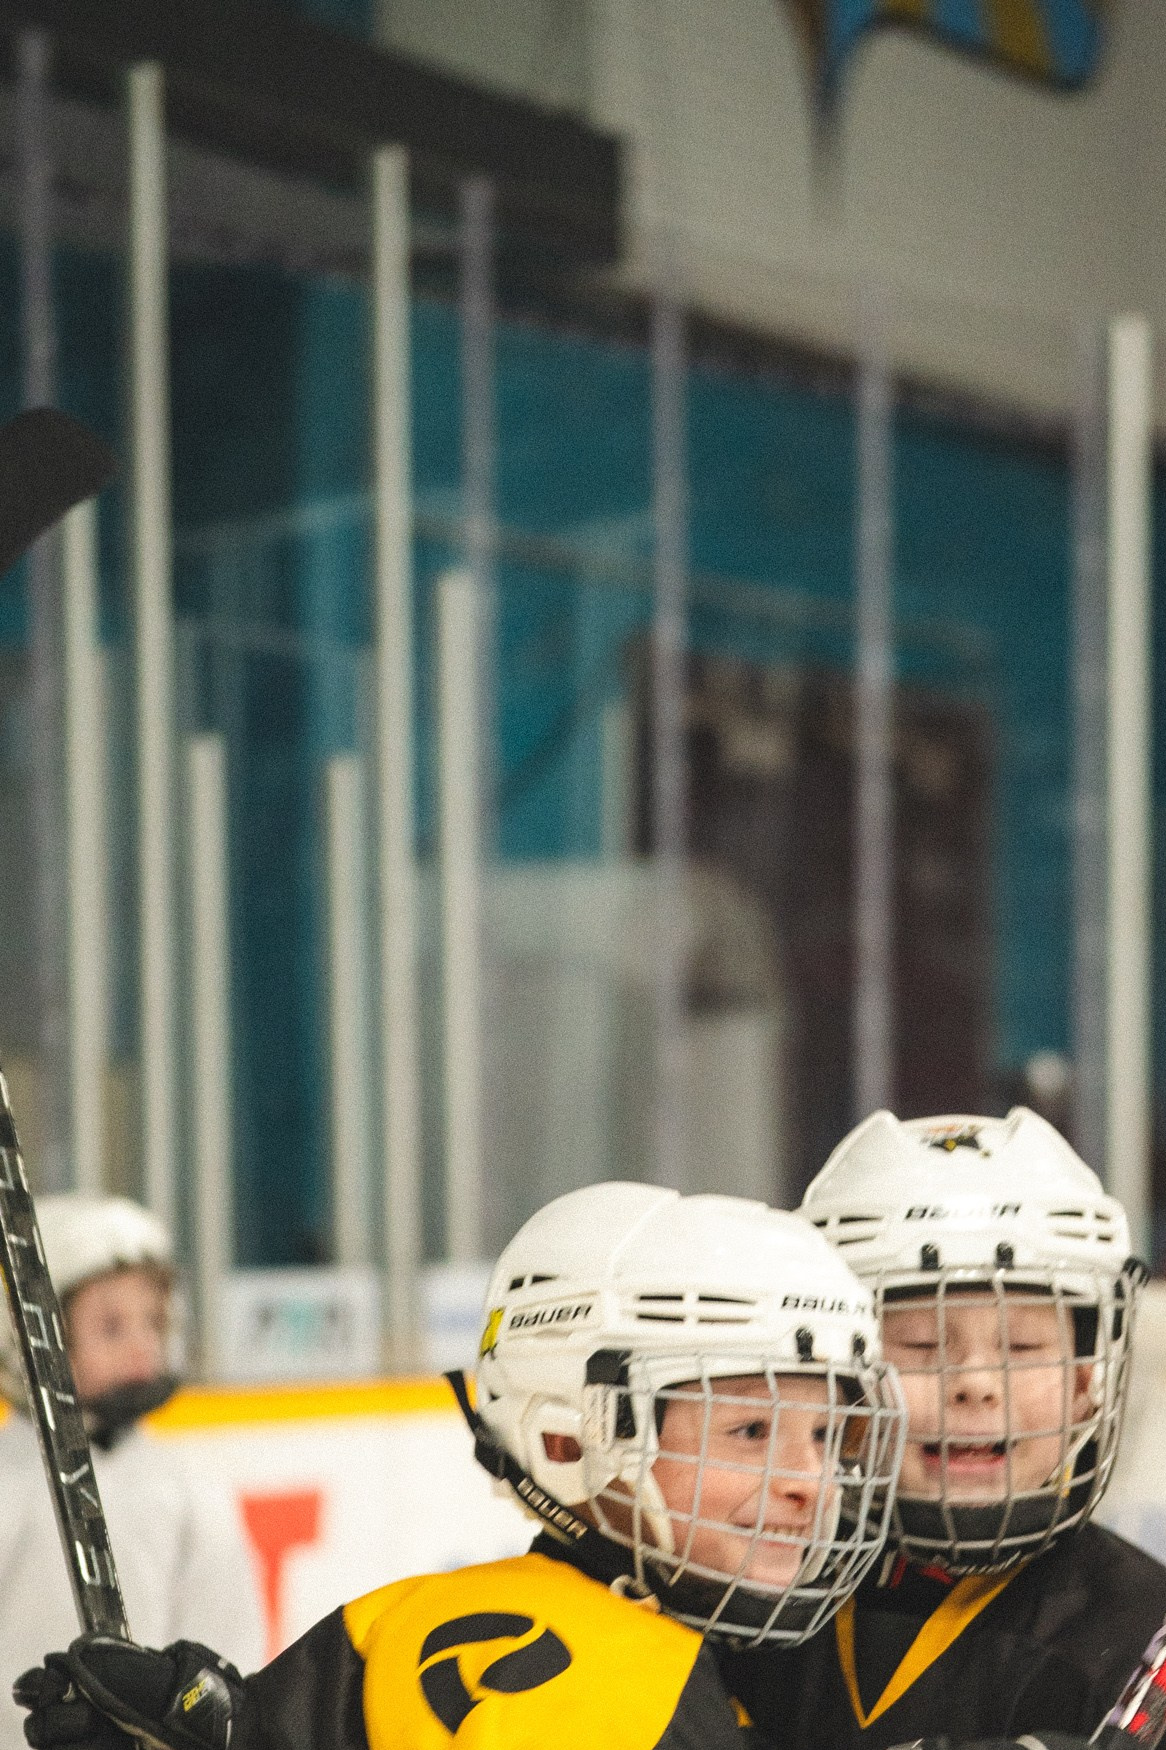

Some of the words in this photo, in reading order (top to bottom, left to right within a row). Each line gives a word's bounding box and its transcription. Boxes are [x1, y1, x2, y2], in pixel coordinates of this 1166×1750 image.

[905, 1202, 1022, 1220] BAER
[509, 1304, 593, 1330] BAUER
[517, 1477, 588, 1539] BAUER
